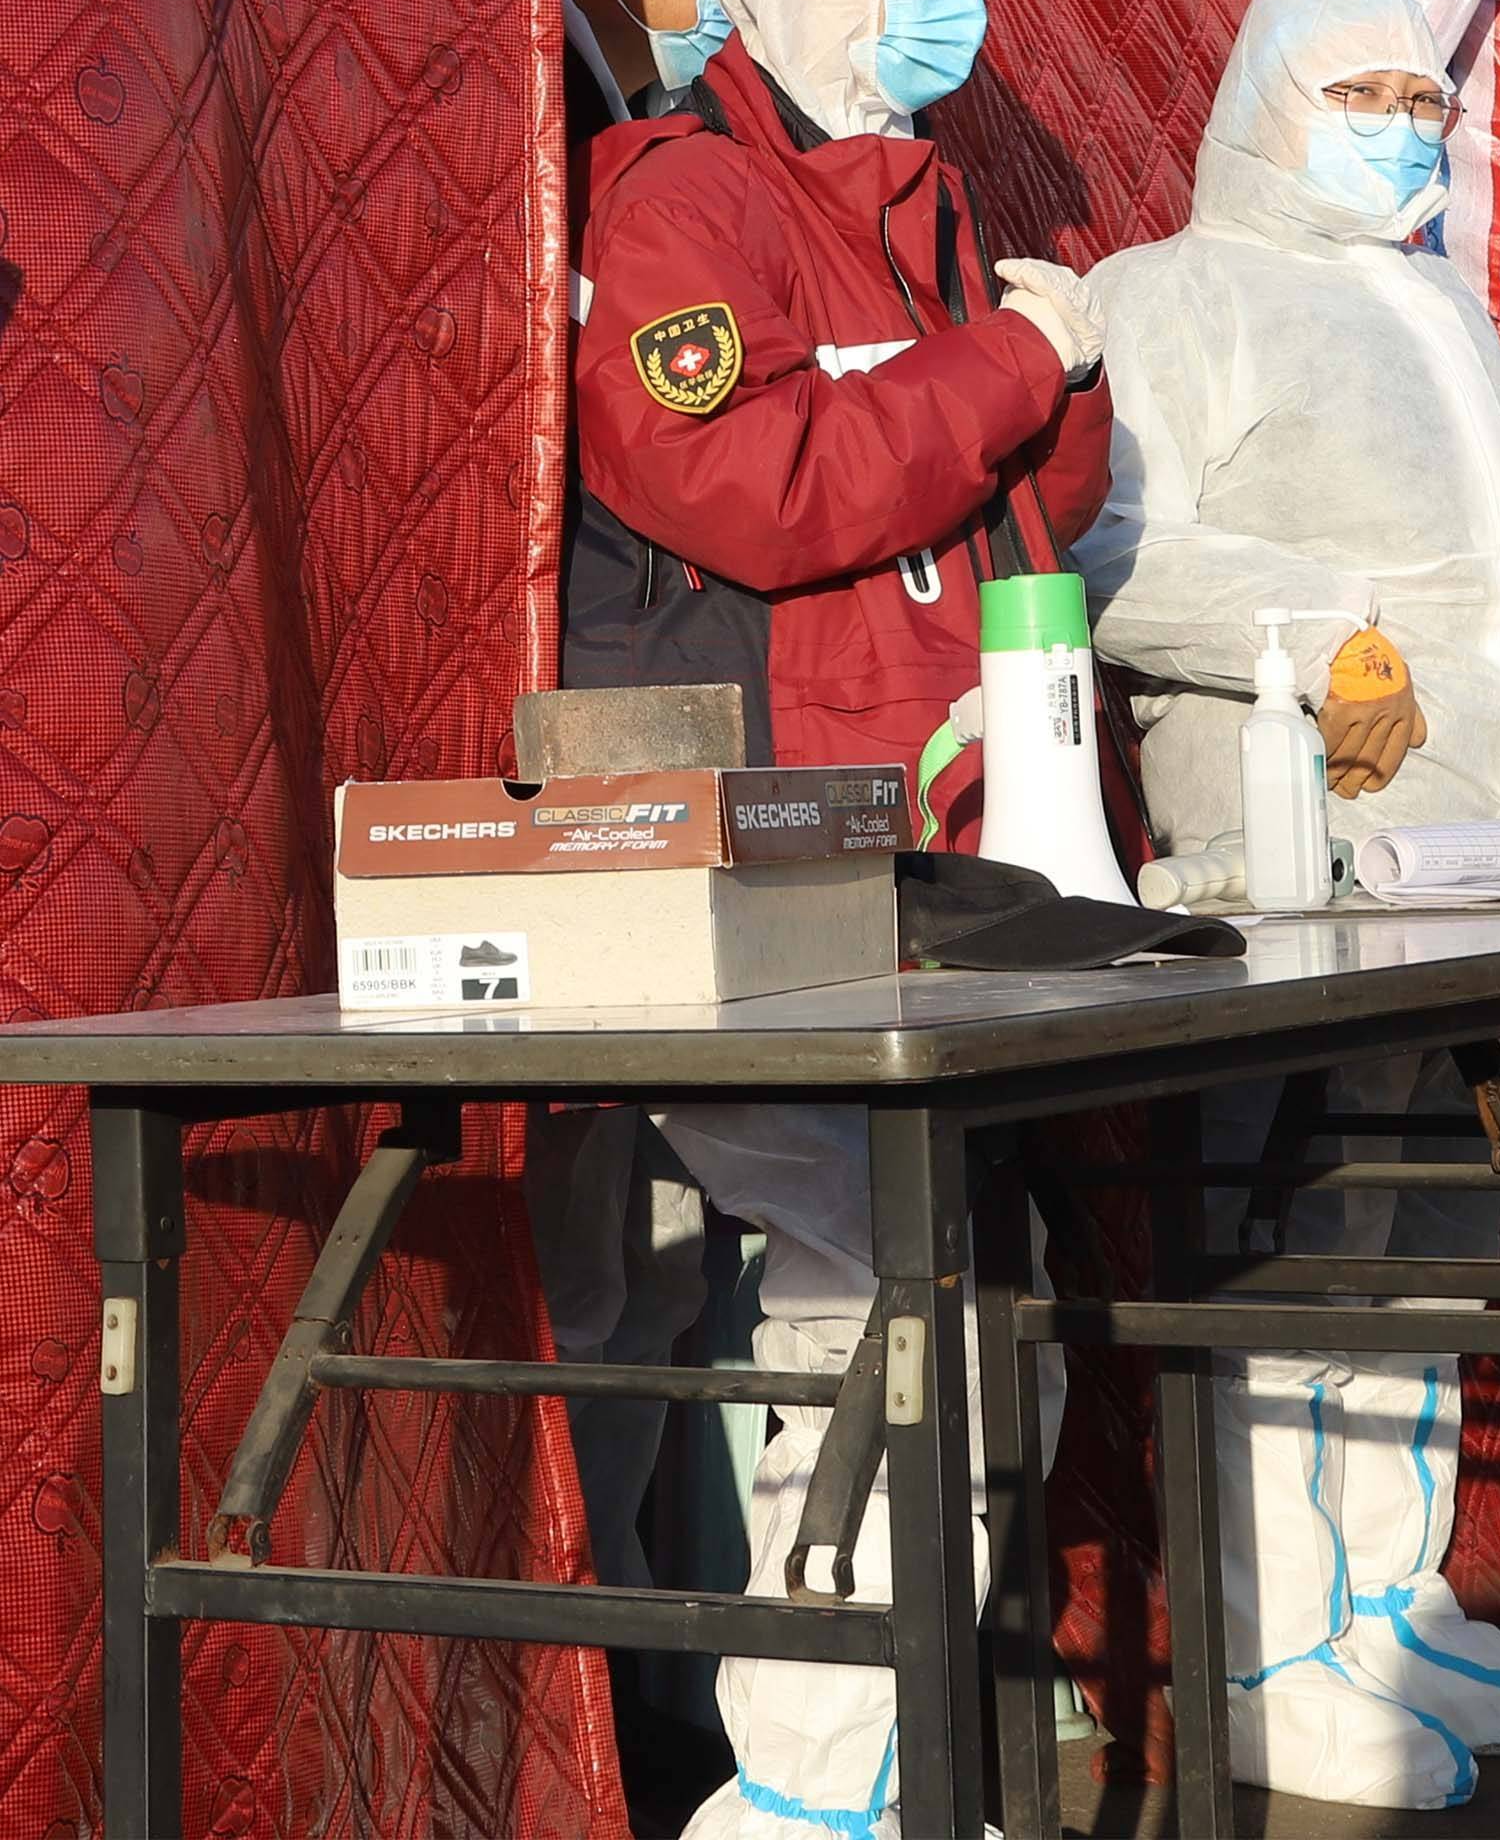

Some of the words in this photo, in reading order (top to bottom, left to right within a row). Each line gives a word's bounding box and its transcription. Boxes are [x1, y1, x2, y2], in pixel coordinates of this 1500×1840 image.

[653, 312, 711, 343] 中国卫生
[872, 779, 898, 806] FIT
[535, 806, 624, 825] CLASSIC
[625, 803, 687, 823] FIT
[735, 802, 821, 830] SKECHERS
[369, 822, 515, 843] SKECHERS
[571, 825, 655, 842] Air-Cooled
[843, 835, 875, 849] MEMORY
[875, 834, 898, 848] FOAM
[549, 841, 619, 852] MEMORY
[619, 839, 668, 850] FOAM
[352, 978, 417, 992] 65905/BBK
[477, 978, 501, 1000] 7
